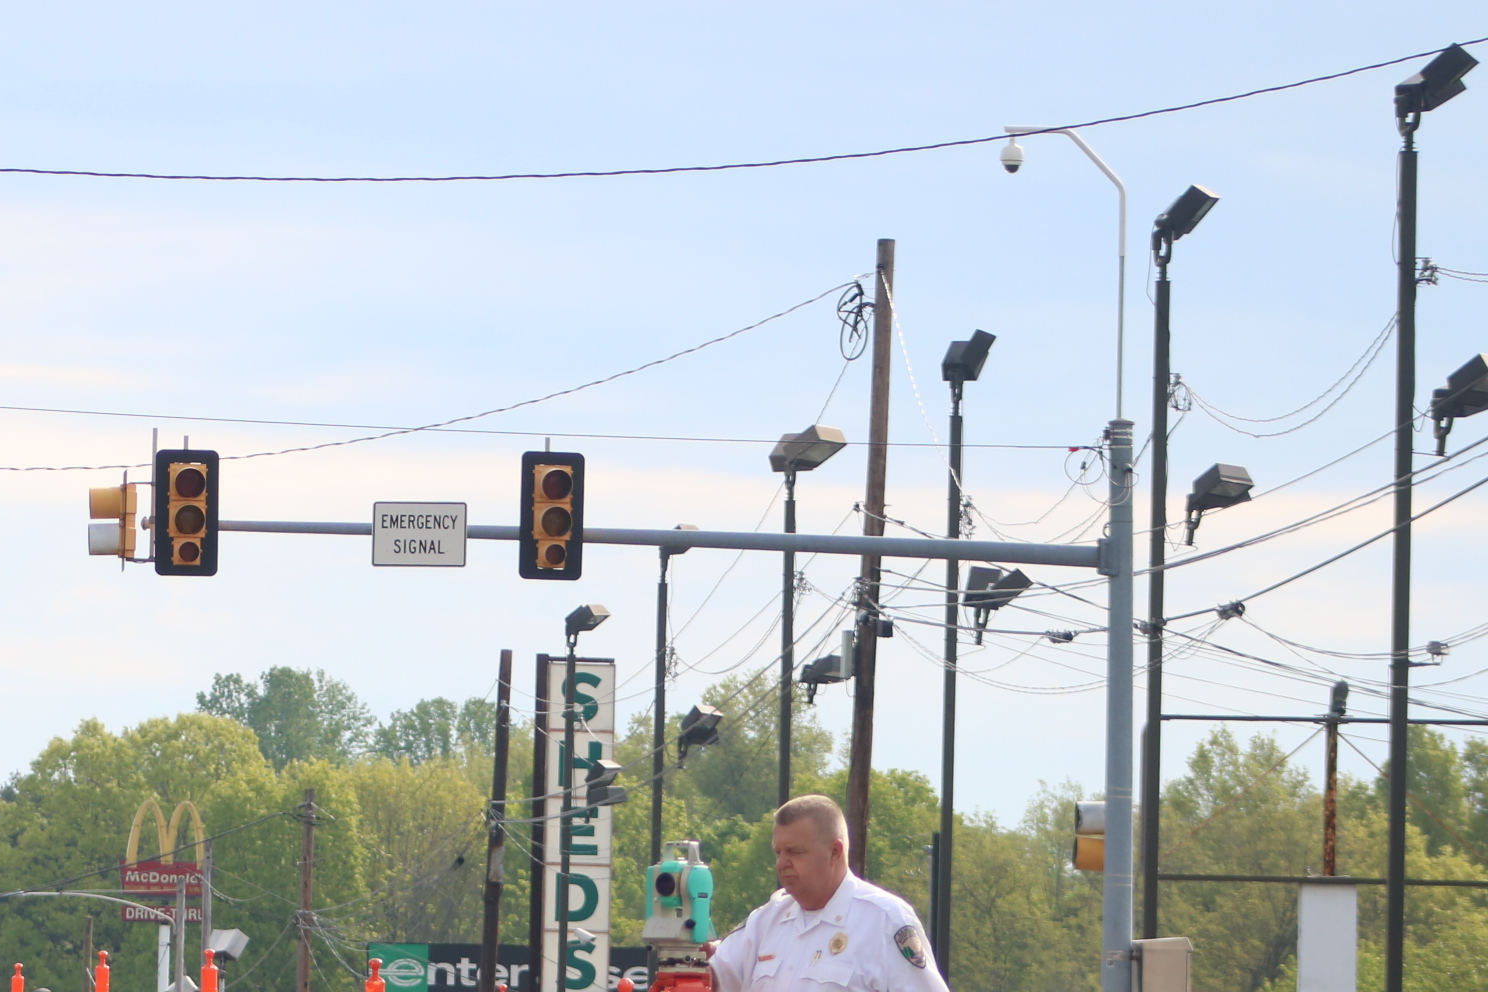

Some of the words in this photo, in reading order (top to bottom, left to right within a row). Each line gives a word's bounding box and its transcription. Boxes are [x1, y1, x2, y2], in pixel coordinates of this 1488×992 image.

[380, 514, 458, 530] EMERGENCY
[393, 539, 445, 554] SIGNAL
[553, 671, 603, 991] SHEDS
